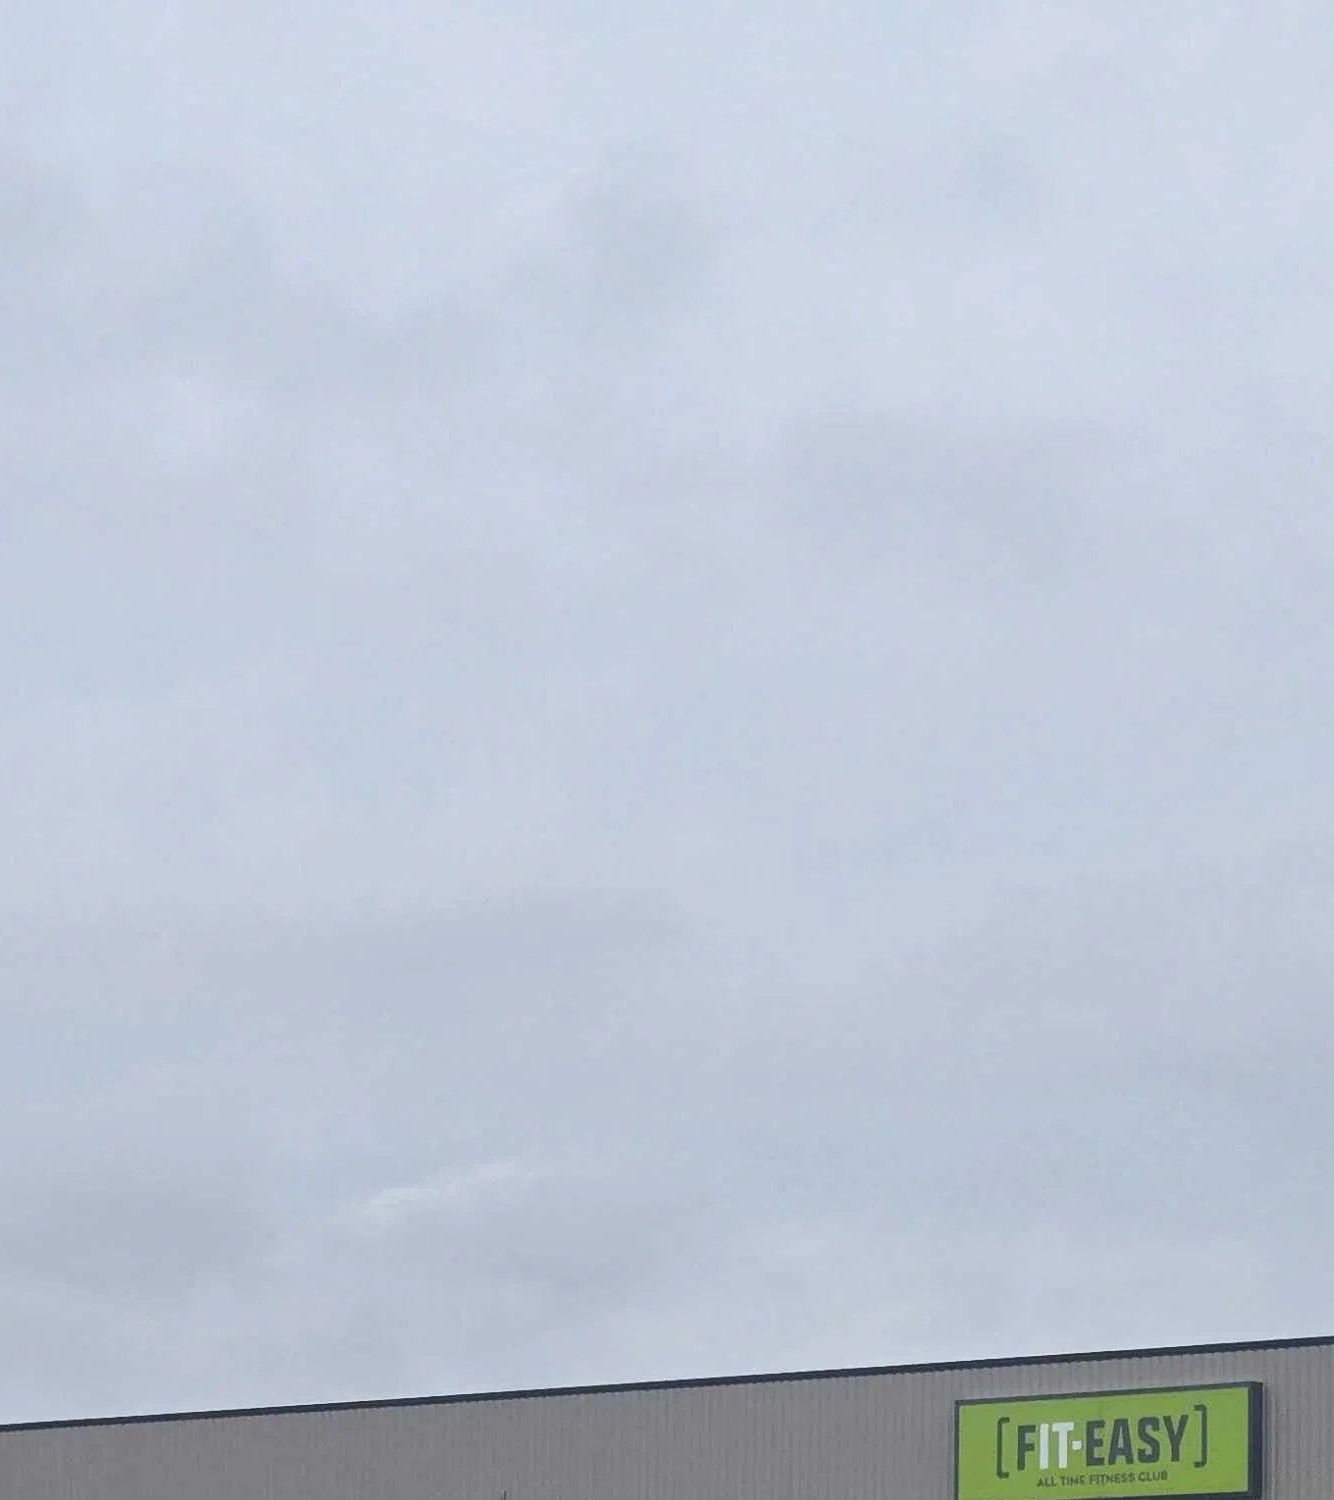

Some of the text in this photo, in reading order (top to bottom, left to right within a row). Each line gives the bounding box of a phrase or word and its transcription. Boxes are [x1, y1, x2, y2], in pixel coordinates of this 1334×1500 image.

[1037, 1470, 1168, 1488] ALL TIME FITNESS CLUB
